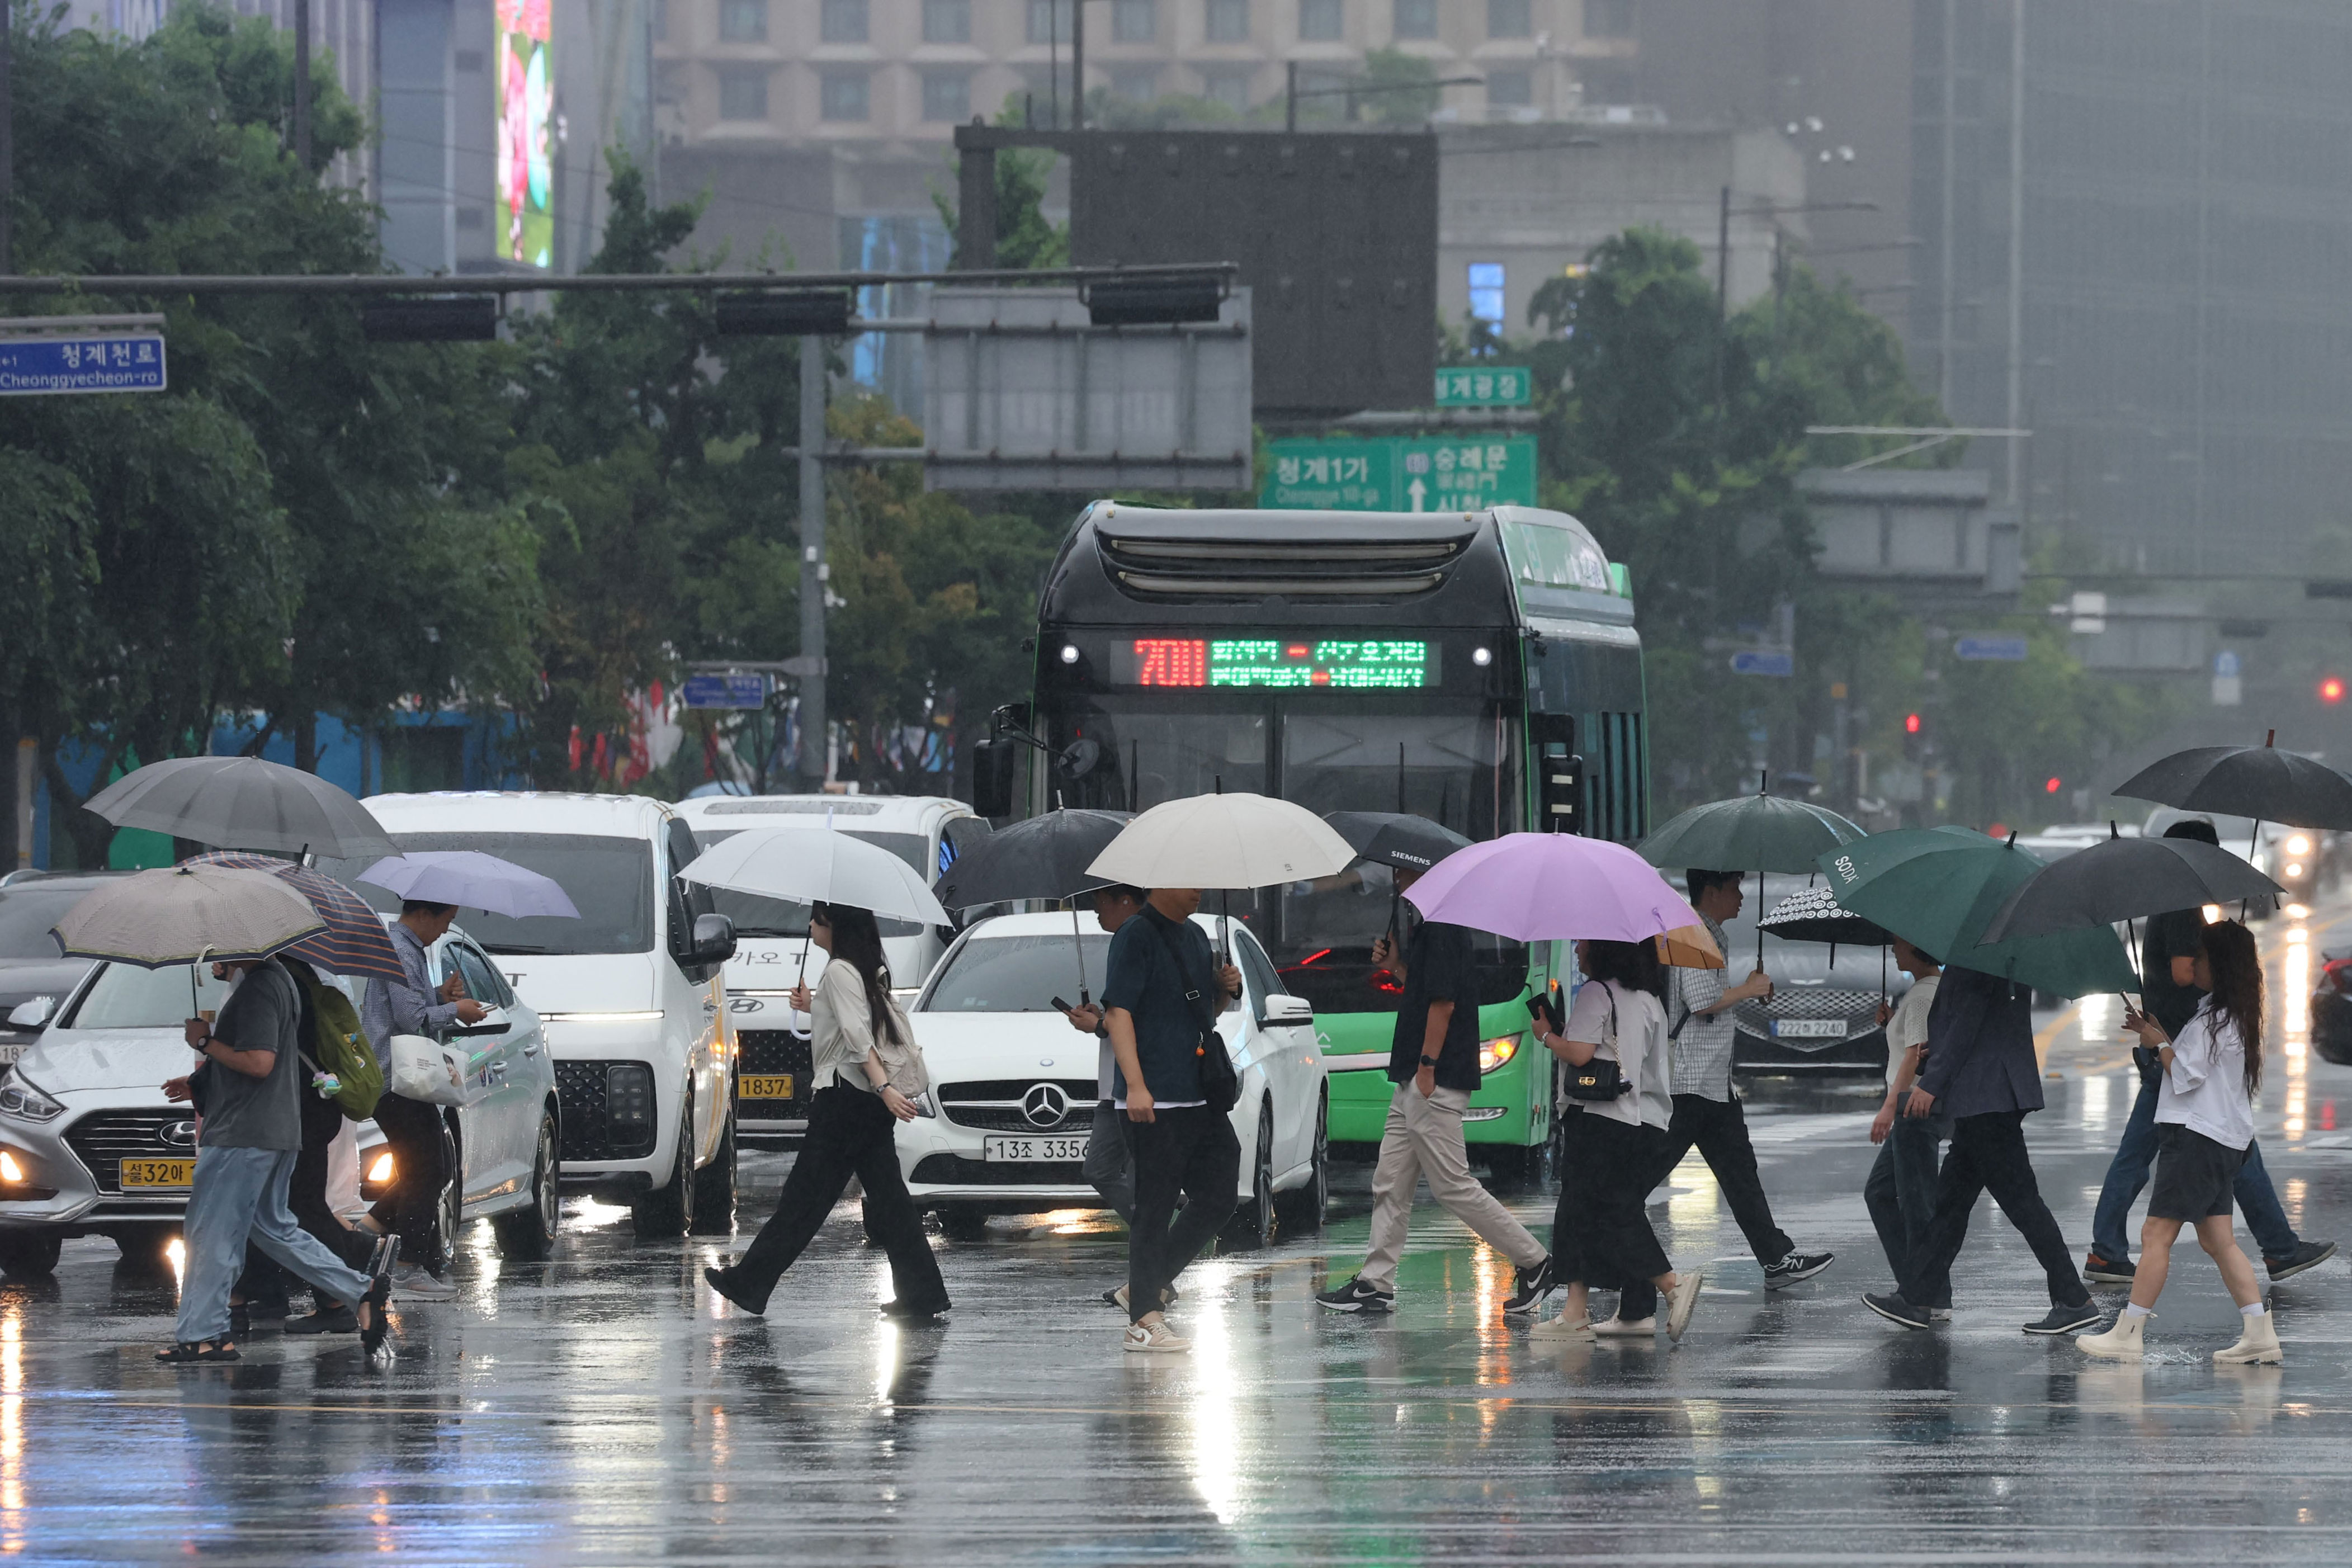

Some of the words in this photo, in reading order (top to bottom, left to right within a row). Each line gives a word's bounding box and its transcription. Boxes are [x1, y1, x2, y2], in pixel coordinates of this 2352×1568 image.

[62, 343, 156, 368] 청계천로
[0, 370, 158, 389] Cheonggyecheon-ro
[1434, 446, 1508, 471] 숭례문
[1391, 851, 1431, 866] SIEMENS
[505, 973, 527, 987] T
[743, 1079, 785, 1095] 1837
[997, 1140, 1032, 1159] 13조
[144, 1164, 183, 1182] 32아
